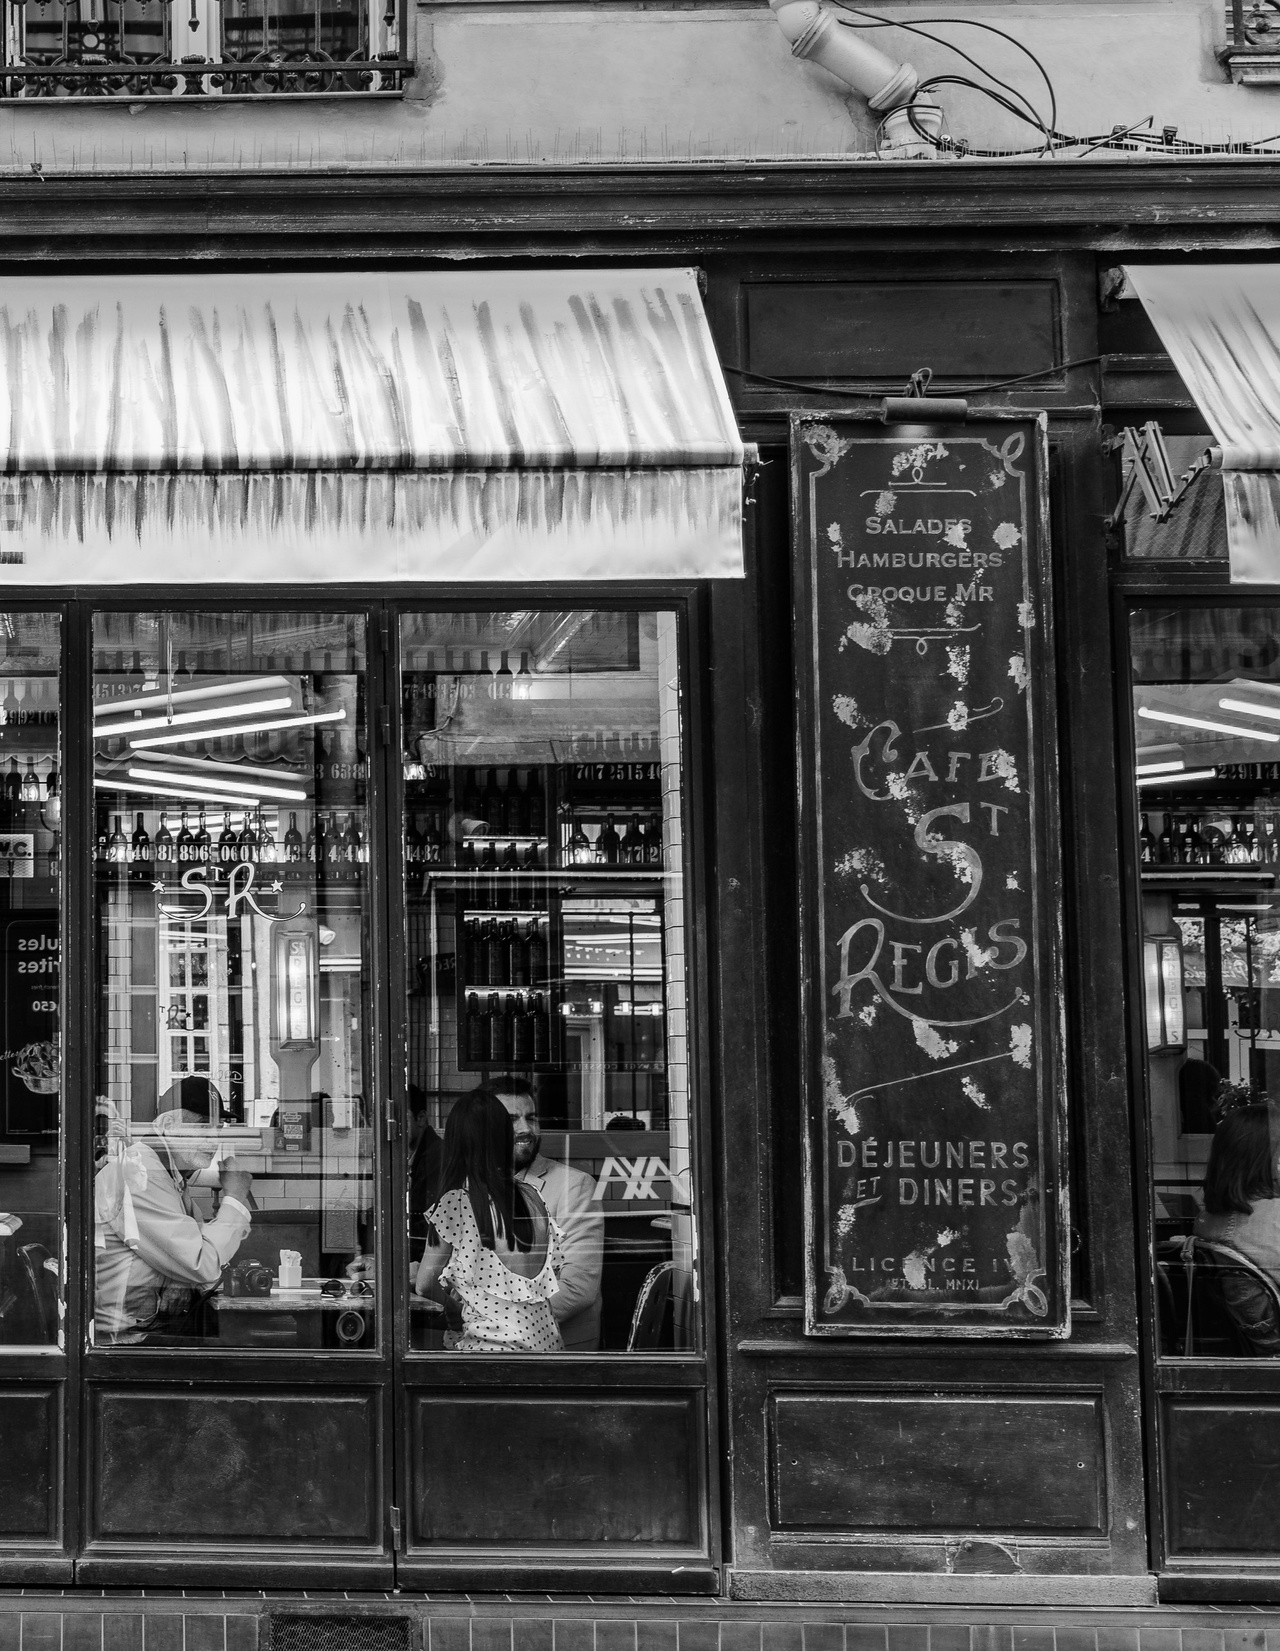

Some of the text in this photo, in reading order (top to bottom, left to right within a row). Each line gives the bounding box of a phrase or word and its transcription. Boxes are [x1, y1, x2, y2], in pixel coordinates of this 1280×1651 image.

[865, 516, 972, 535] SALADES
[837, 550, 1003, 569] HAMBURGERS
[846, 584, 947, 602] CROQUE
[837, 1136, 1029, 1169] DÉJEUNERS
[591, 1156, 690, 1200] AXA
[857, 1176, 1018, 1207] ET DINERS
